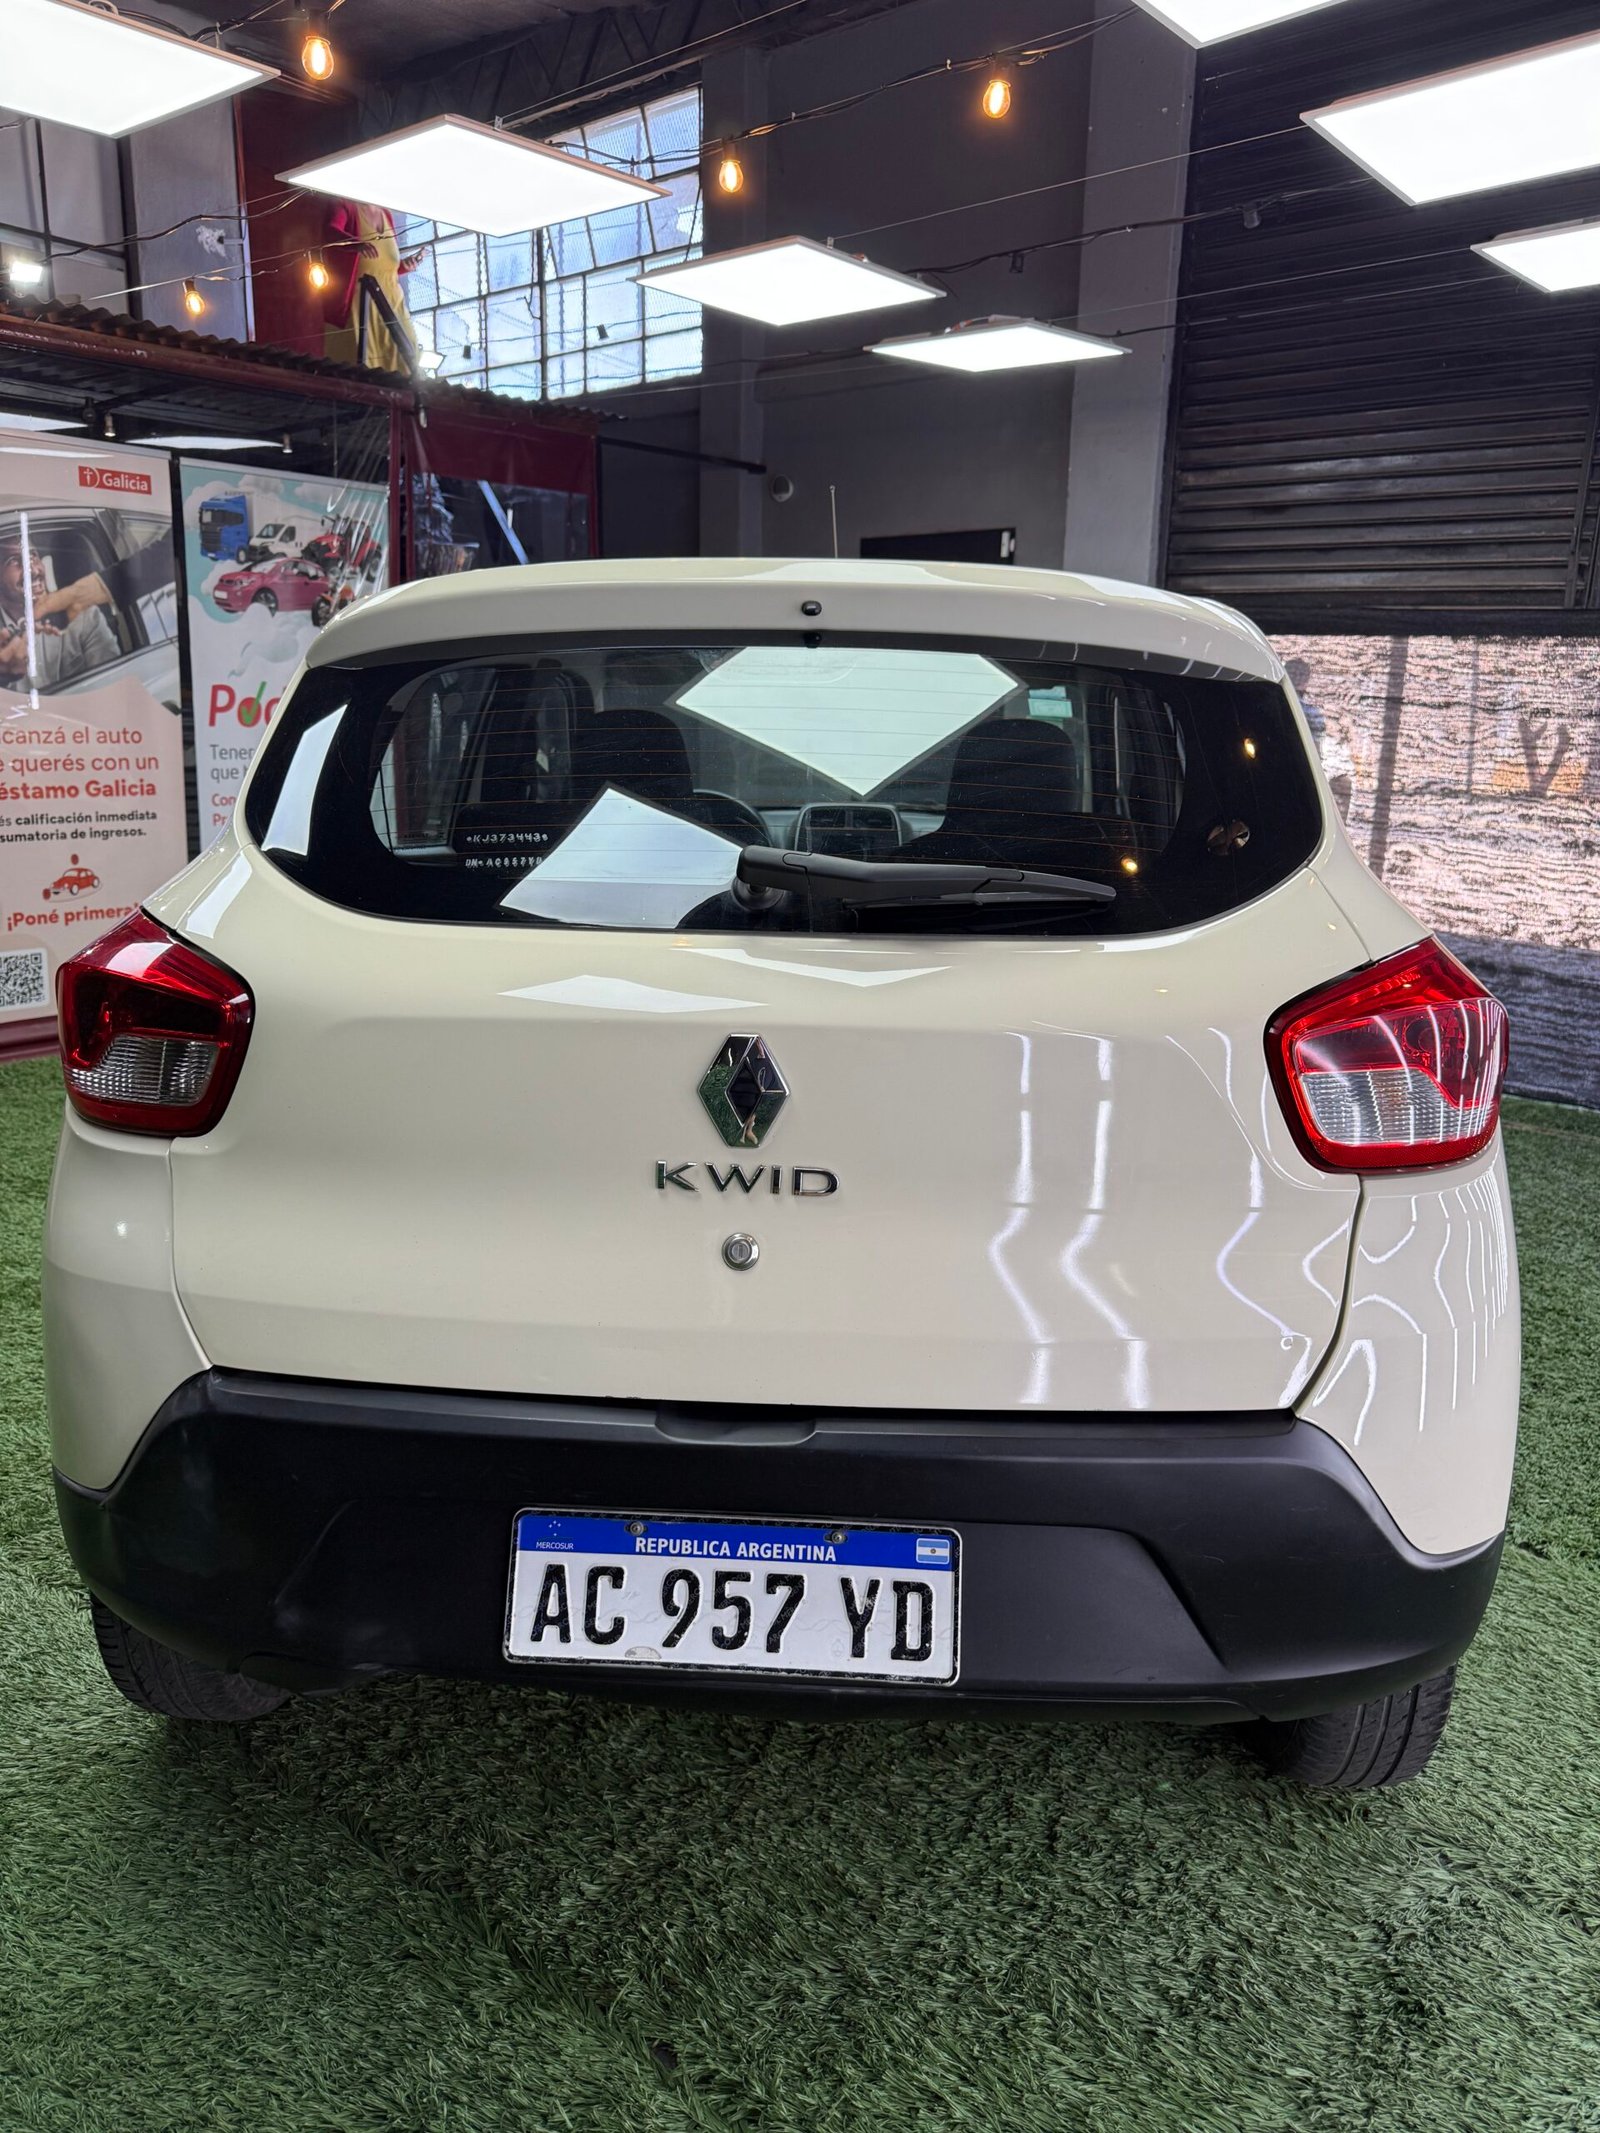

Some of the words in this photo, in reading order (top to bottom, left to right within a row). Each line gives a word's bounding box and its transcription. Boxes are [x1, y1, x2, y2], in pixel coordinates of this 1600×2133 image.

[102, 472, 149, 492] Galicia
[0, 726, 66, 744] canzá
[72, 726, 89, 744] el
[96, 727, 142, 744] auto
[11, 754, 85, 776] querés
[91, 757, 130, 771] con
[136, 756, 159, 770] un
[210, 767, 240, 784] que
[85, 778, 157, 797] Galicia
[15, 812, 92, 826] calificación
[95, 810, 157, 823] inmediata
[0, 829, 67, 843] sumatoria
[70, 828, 86, 839] de
[89, 827, 147, 840] ingresos.
[7, 909, 59, 931] ¡Poné
[656, 1160, 840, 1196] KWID
[535, 1541, 574, 1550] MERCOSUR
[635, 1536, 731, 1557] REPUBLICA
[736, 1541, 837, 1562] ARGENTINA
[530, 1563, 626, 1646] AC
[661, 1568, 806, 1654] 957
[839, 1576, 935, 1661] YD
